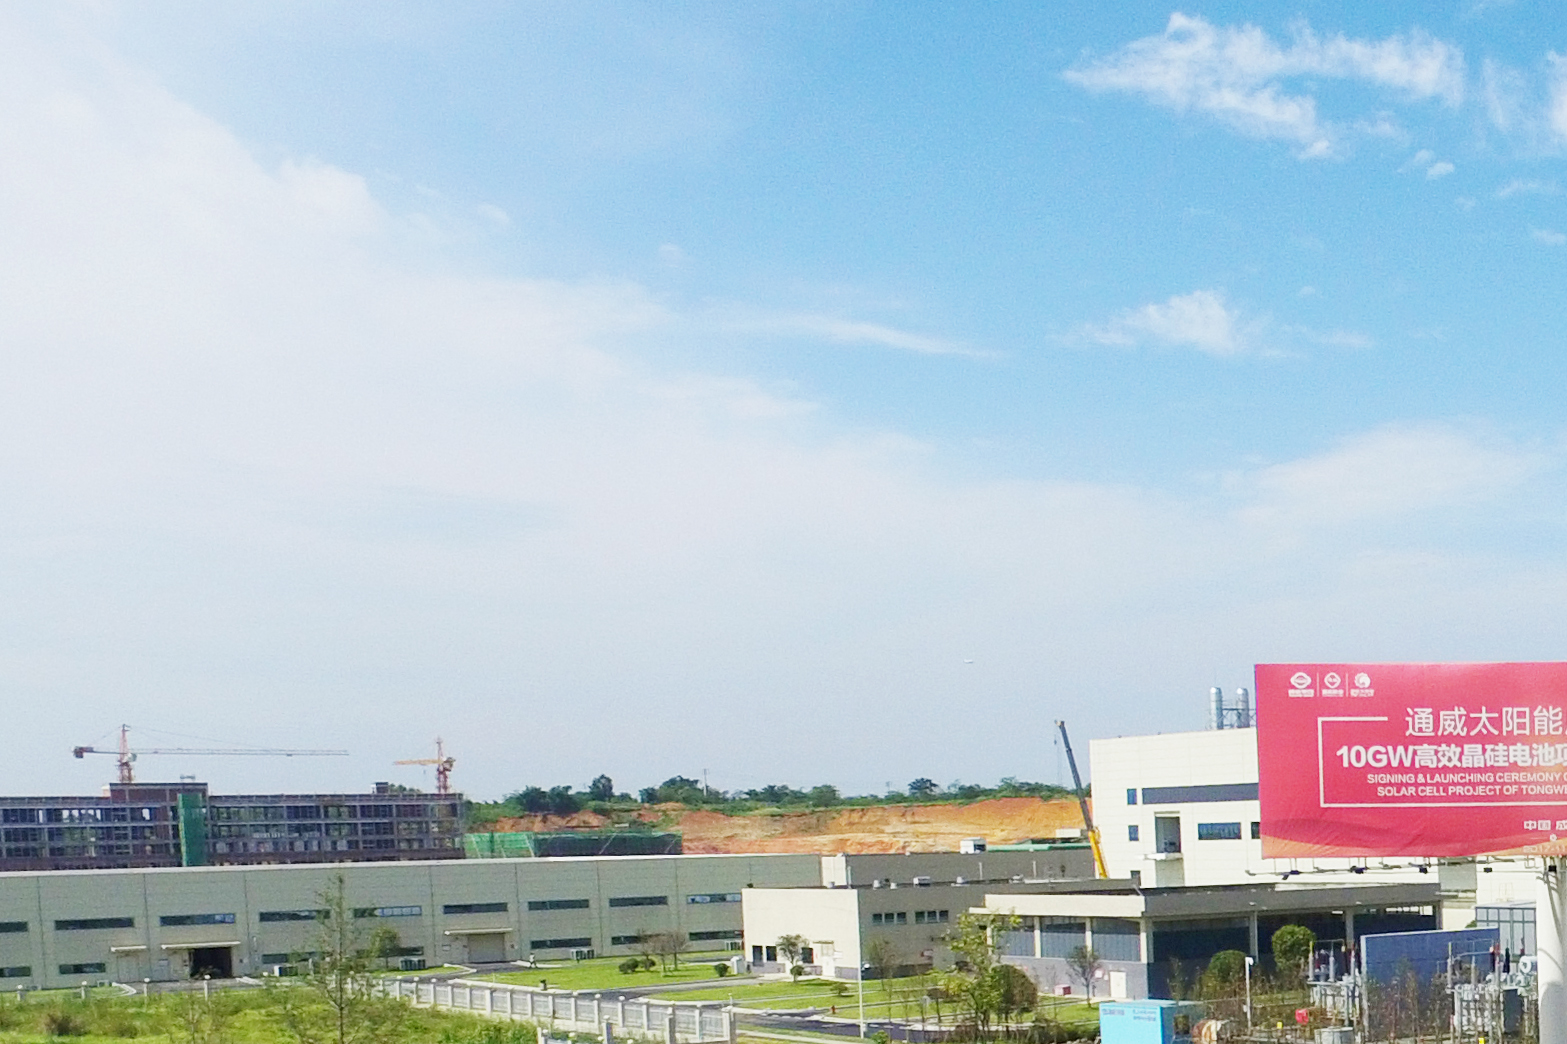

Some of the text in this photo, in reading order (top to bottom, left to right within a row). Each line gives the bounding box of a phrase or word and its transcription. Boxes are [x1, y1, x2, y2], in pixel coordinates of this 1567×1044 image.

[1367, 773, 1415, 784] SIGNING
[1417, 773, 1425, 783] &
[1427, 773, 1494, 783] LAUNCHING
[1496, 772, 1560, 782] CEREMONY
[1377, 786, 1416, 796] SOLAR
[1418, 786, 1446, 796] CELL
[1448, 785, 1501, 796] PROJECT
[1503, 785, 1519, 795] OF
[1524, 820, 1551, 830] 中国
